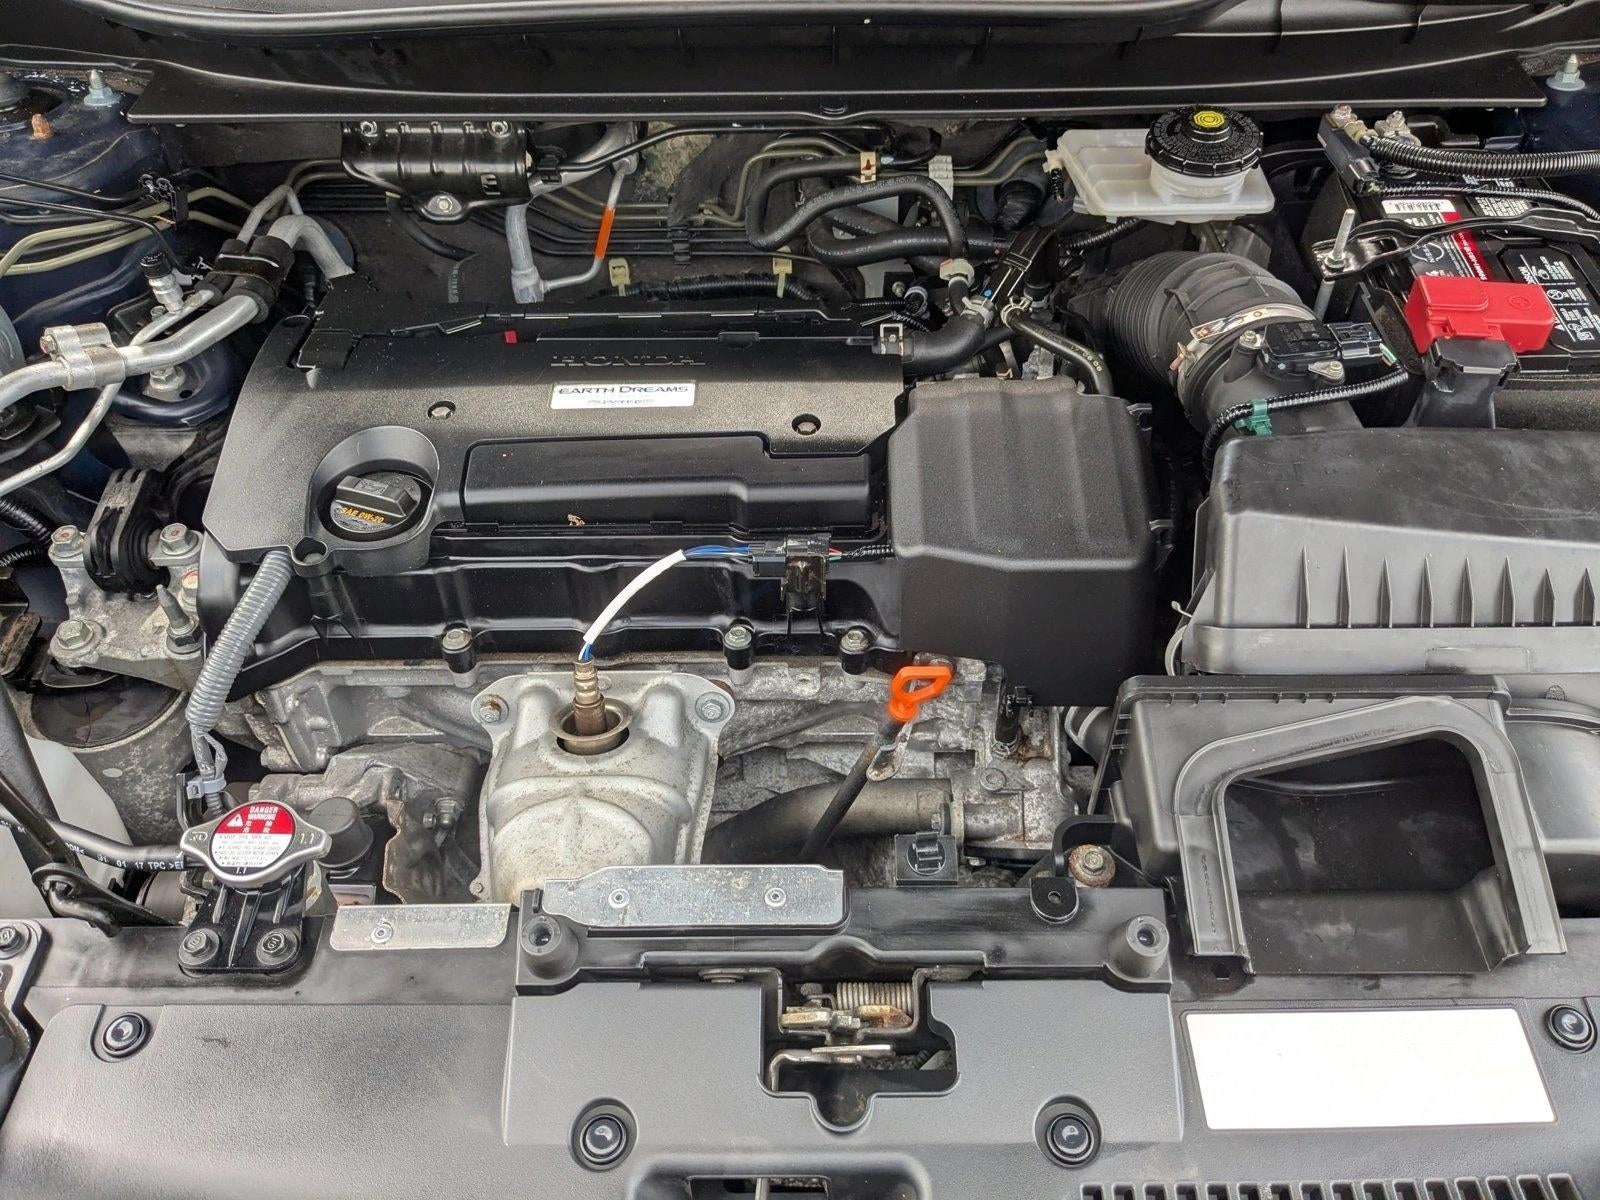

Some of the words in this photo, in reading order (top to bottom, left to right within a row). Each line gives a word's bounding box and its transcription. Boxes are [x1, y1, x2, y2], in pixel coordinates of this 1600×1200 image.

[550, 355, 706, 367] HONDA
[558, 386, 615, 394] EARTH
[619, 385, 689, 393] DREAMS
[340, 506, 359, 516] SAE
[359, 511, 385, 523] 0W-20
[249, 806, 279, 814] DANGER
[147, 861, 166, 870] TPC
